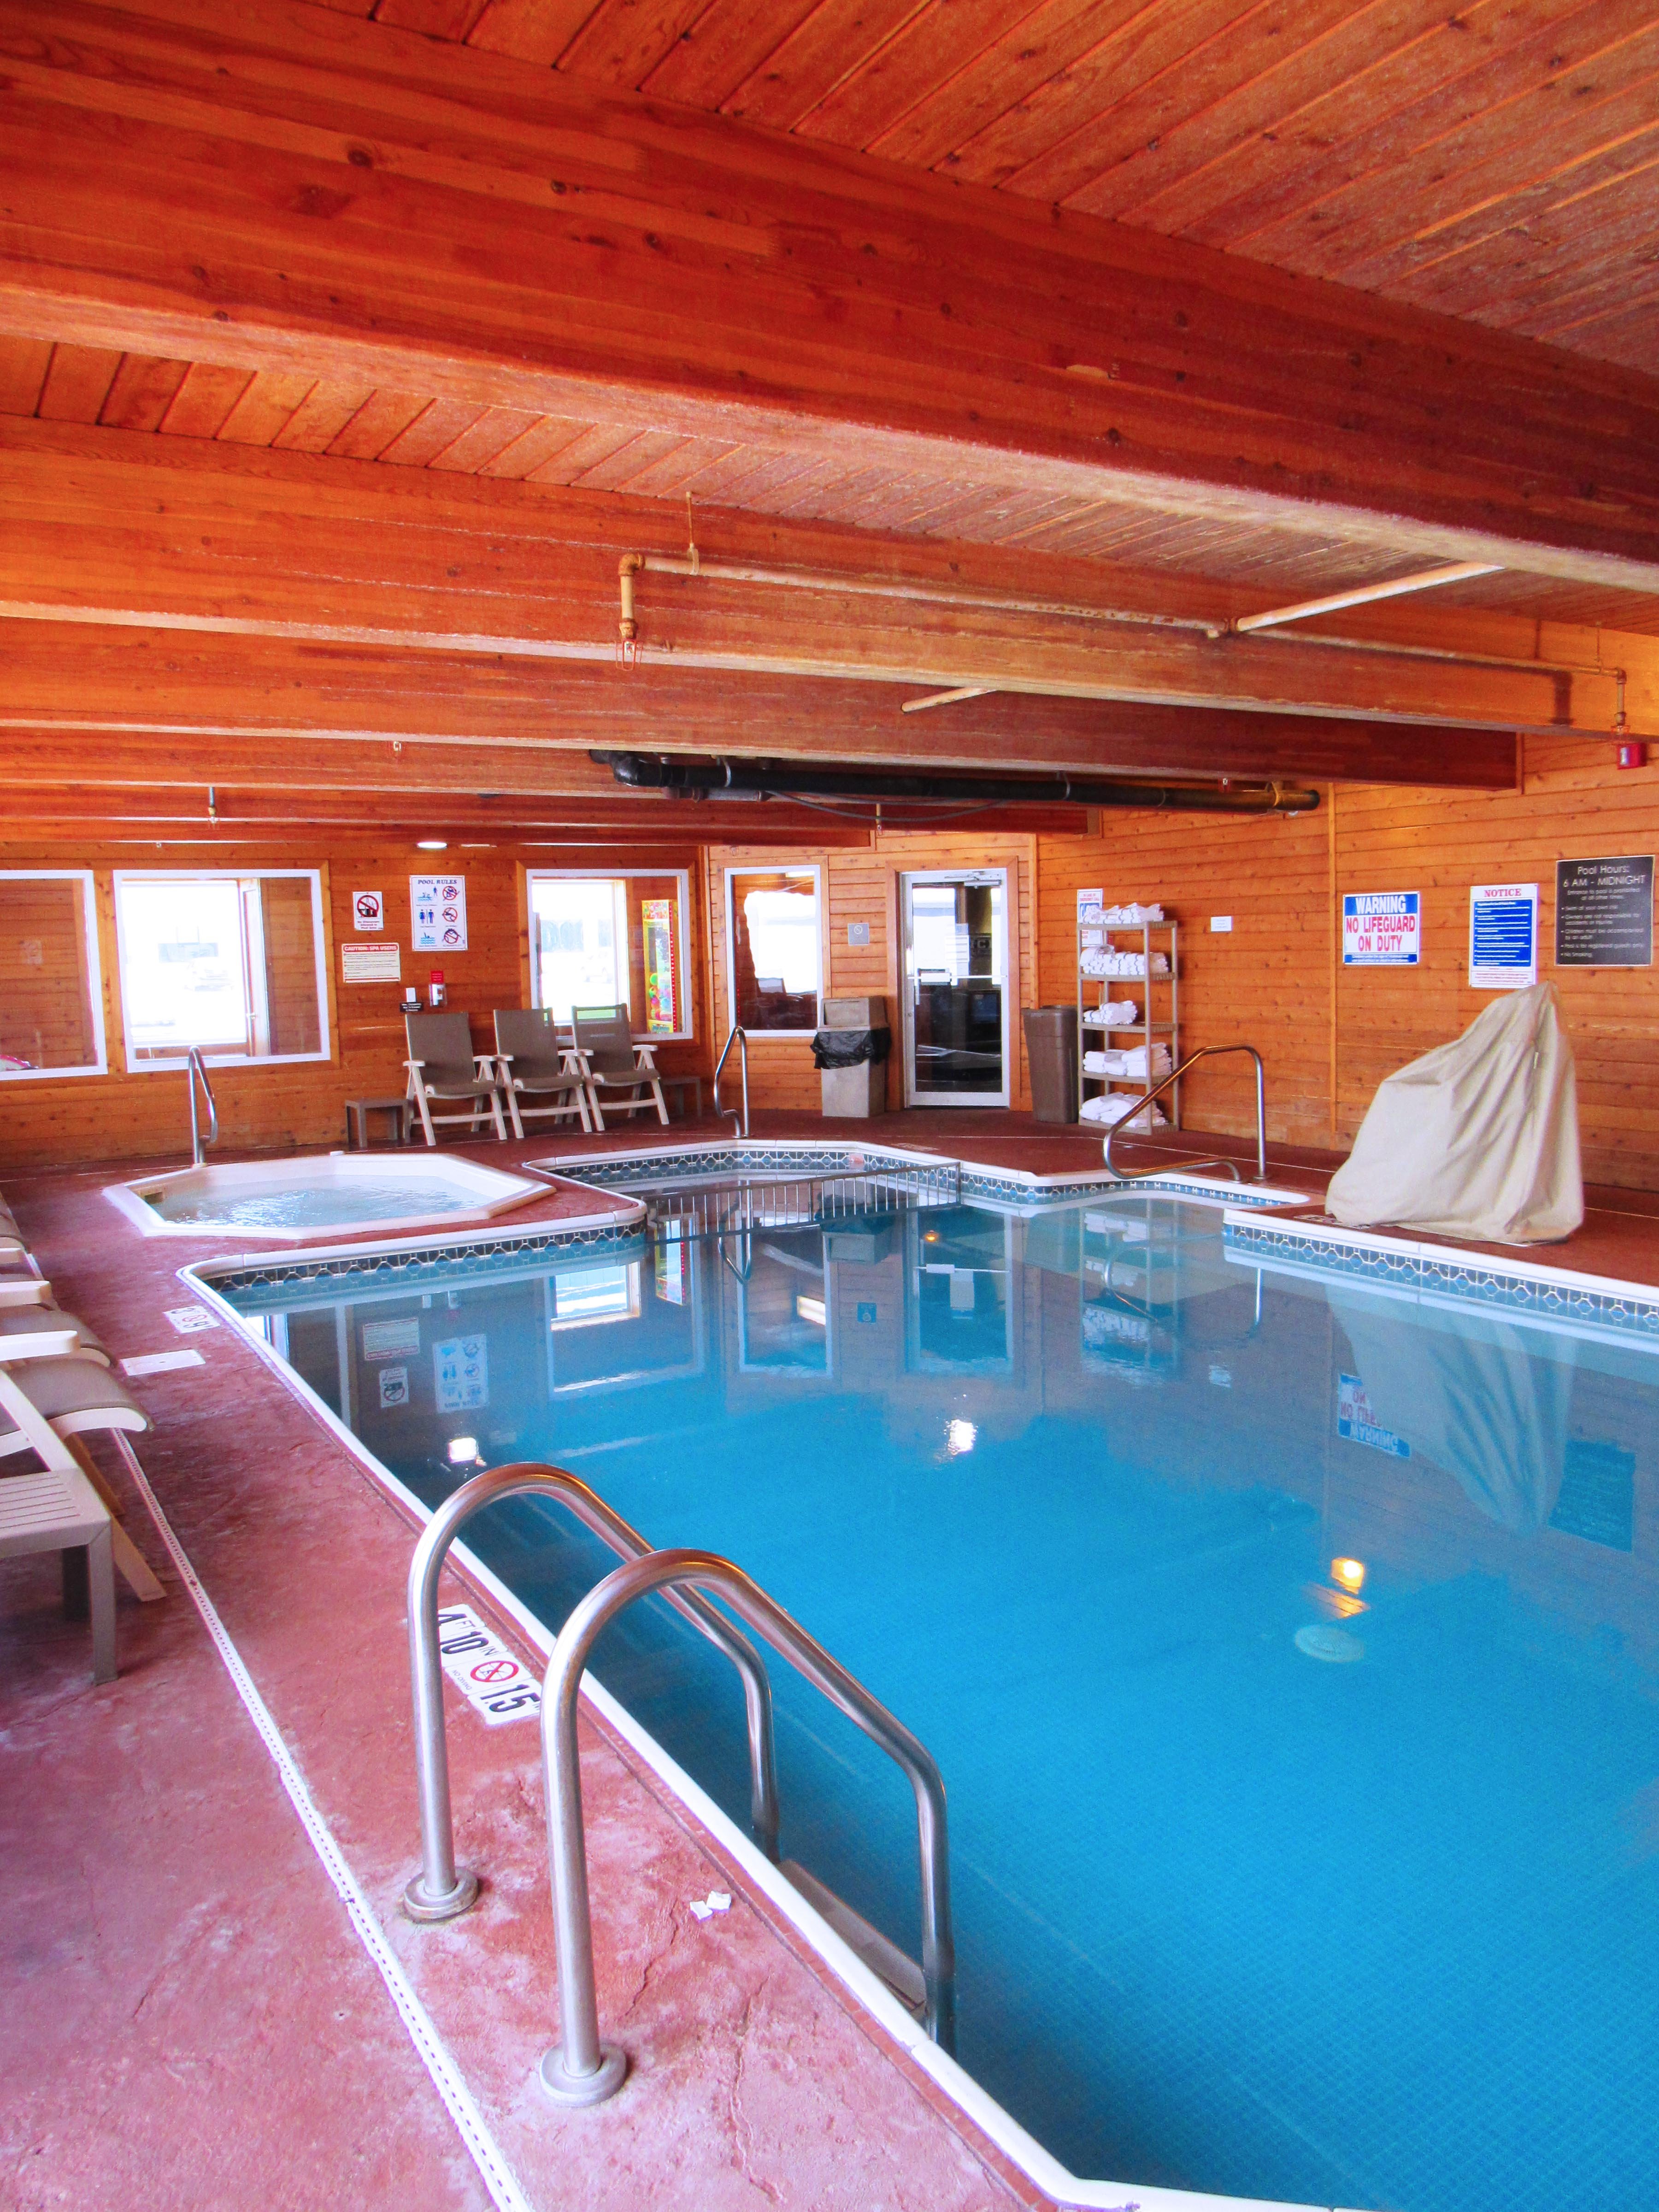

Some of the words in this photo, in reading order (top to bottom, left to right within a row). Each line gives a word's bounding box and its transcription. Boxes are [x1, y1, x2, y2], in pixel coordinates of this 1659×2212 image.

[1577, 866, 1597, 875] Pool
[1571, 878, 1588, 887] AM
[1597, 875, 1646, 885] MIDNIGHT
[1484, 888, 1522, 897] NOTICE
[1355, 895, 1406, 914] WARNING
[1346, 917, 1359, 933] NO
[1364, 916, 1415, 933] LIFEGUARD
[1358, 935, 1371, 952] ON
[1377, 935, 1402, 952] DUTY
[440, 1630, 489, 1654] 10
[479, 1646, 499, 1656] IN
